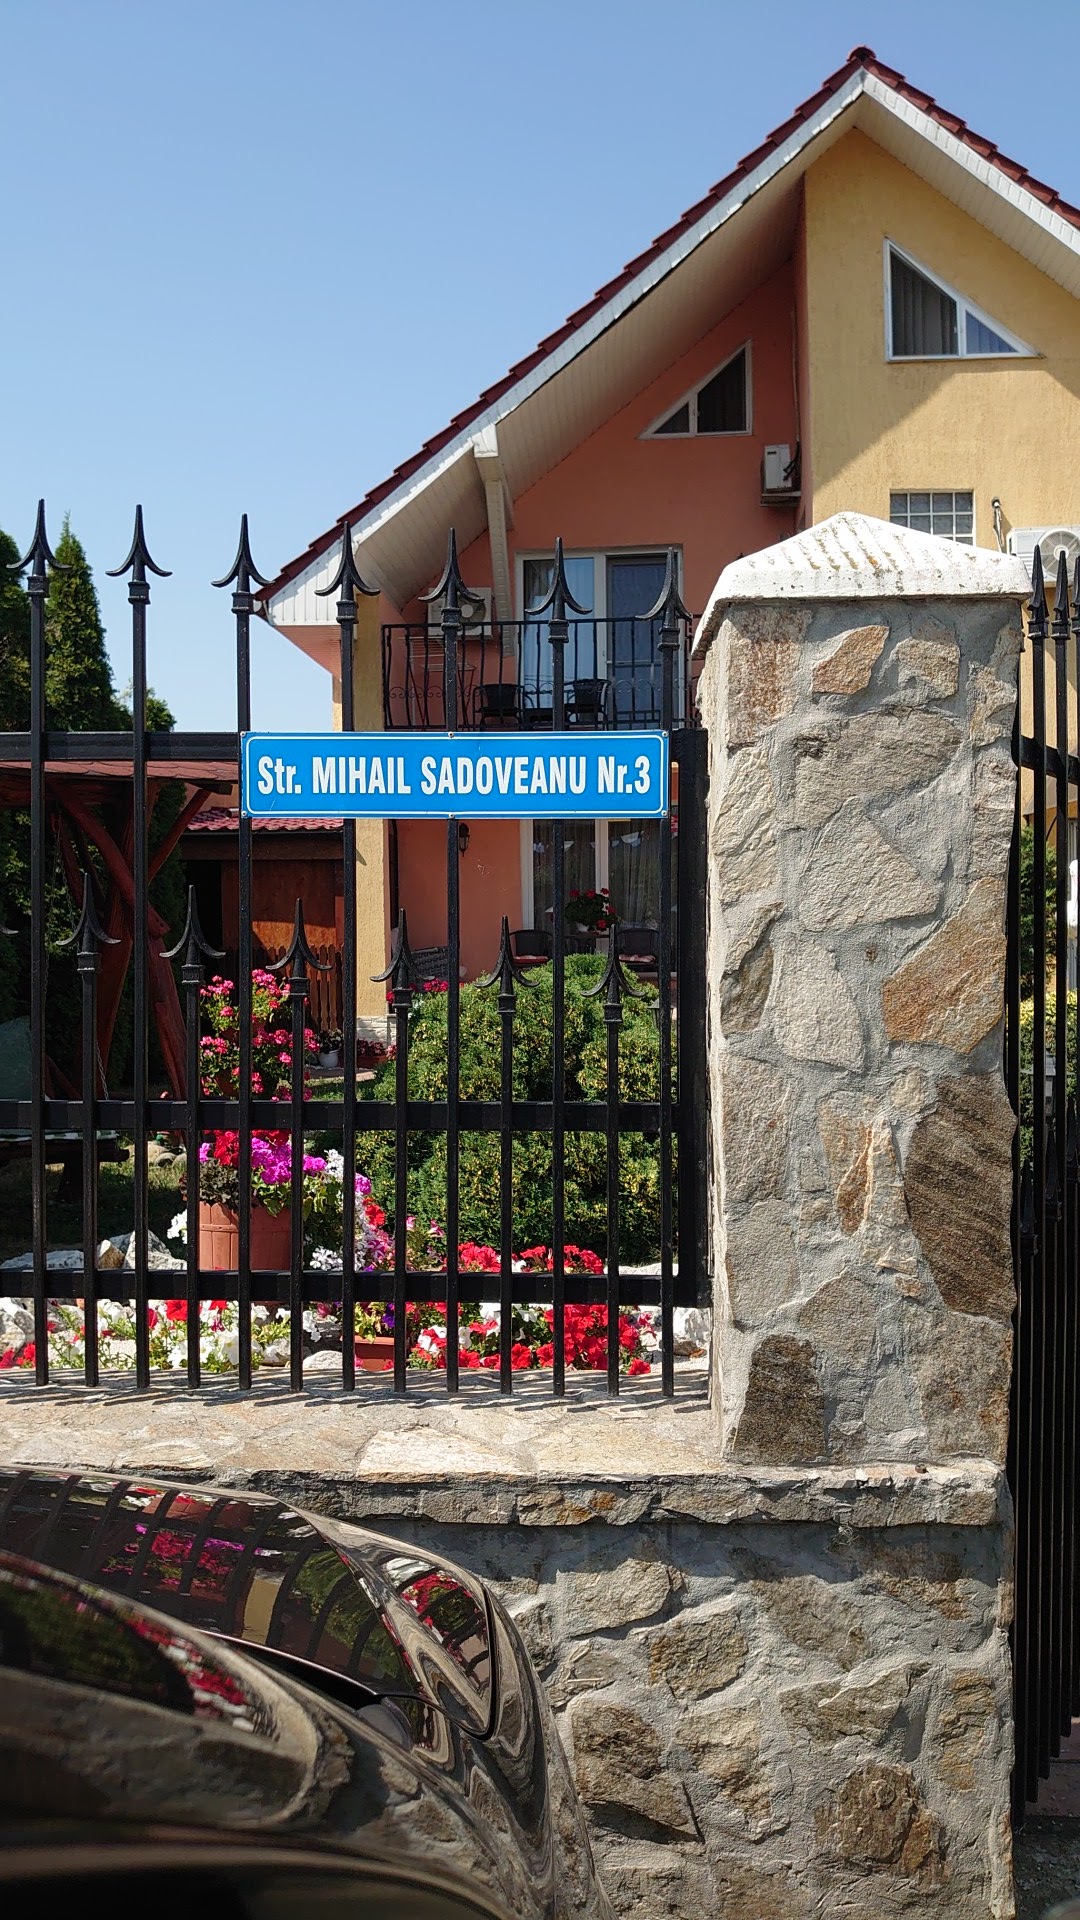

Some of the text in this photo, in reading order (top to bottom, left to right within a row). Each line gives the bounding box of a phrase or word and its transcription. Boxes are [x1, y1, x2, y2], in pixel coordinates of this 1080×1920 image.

[257, 755, 650, 795] Str. MIHAIL SADOVEANU Nr.3
